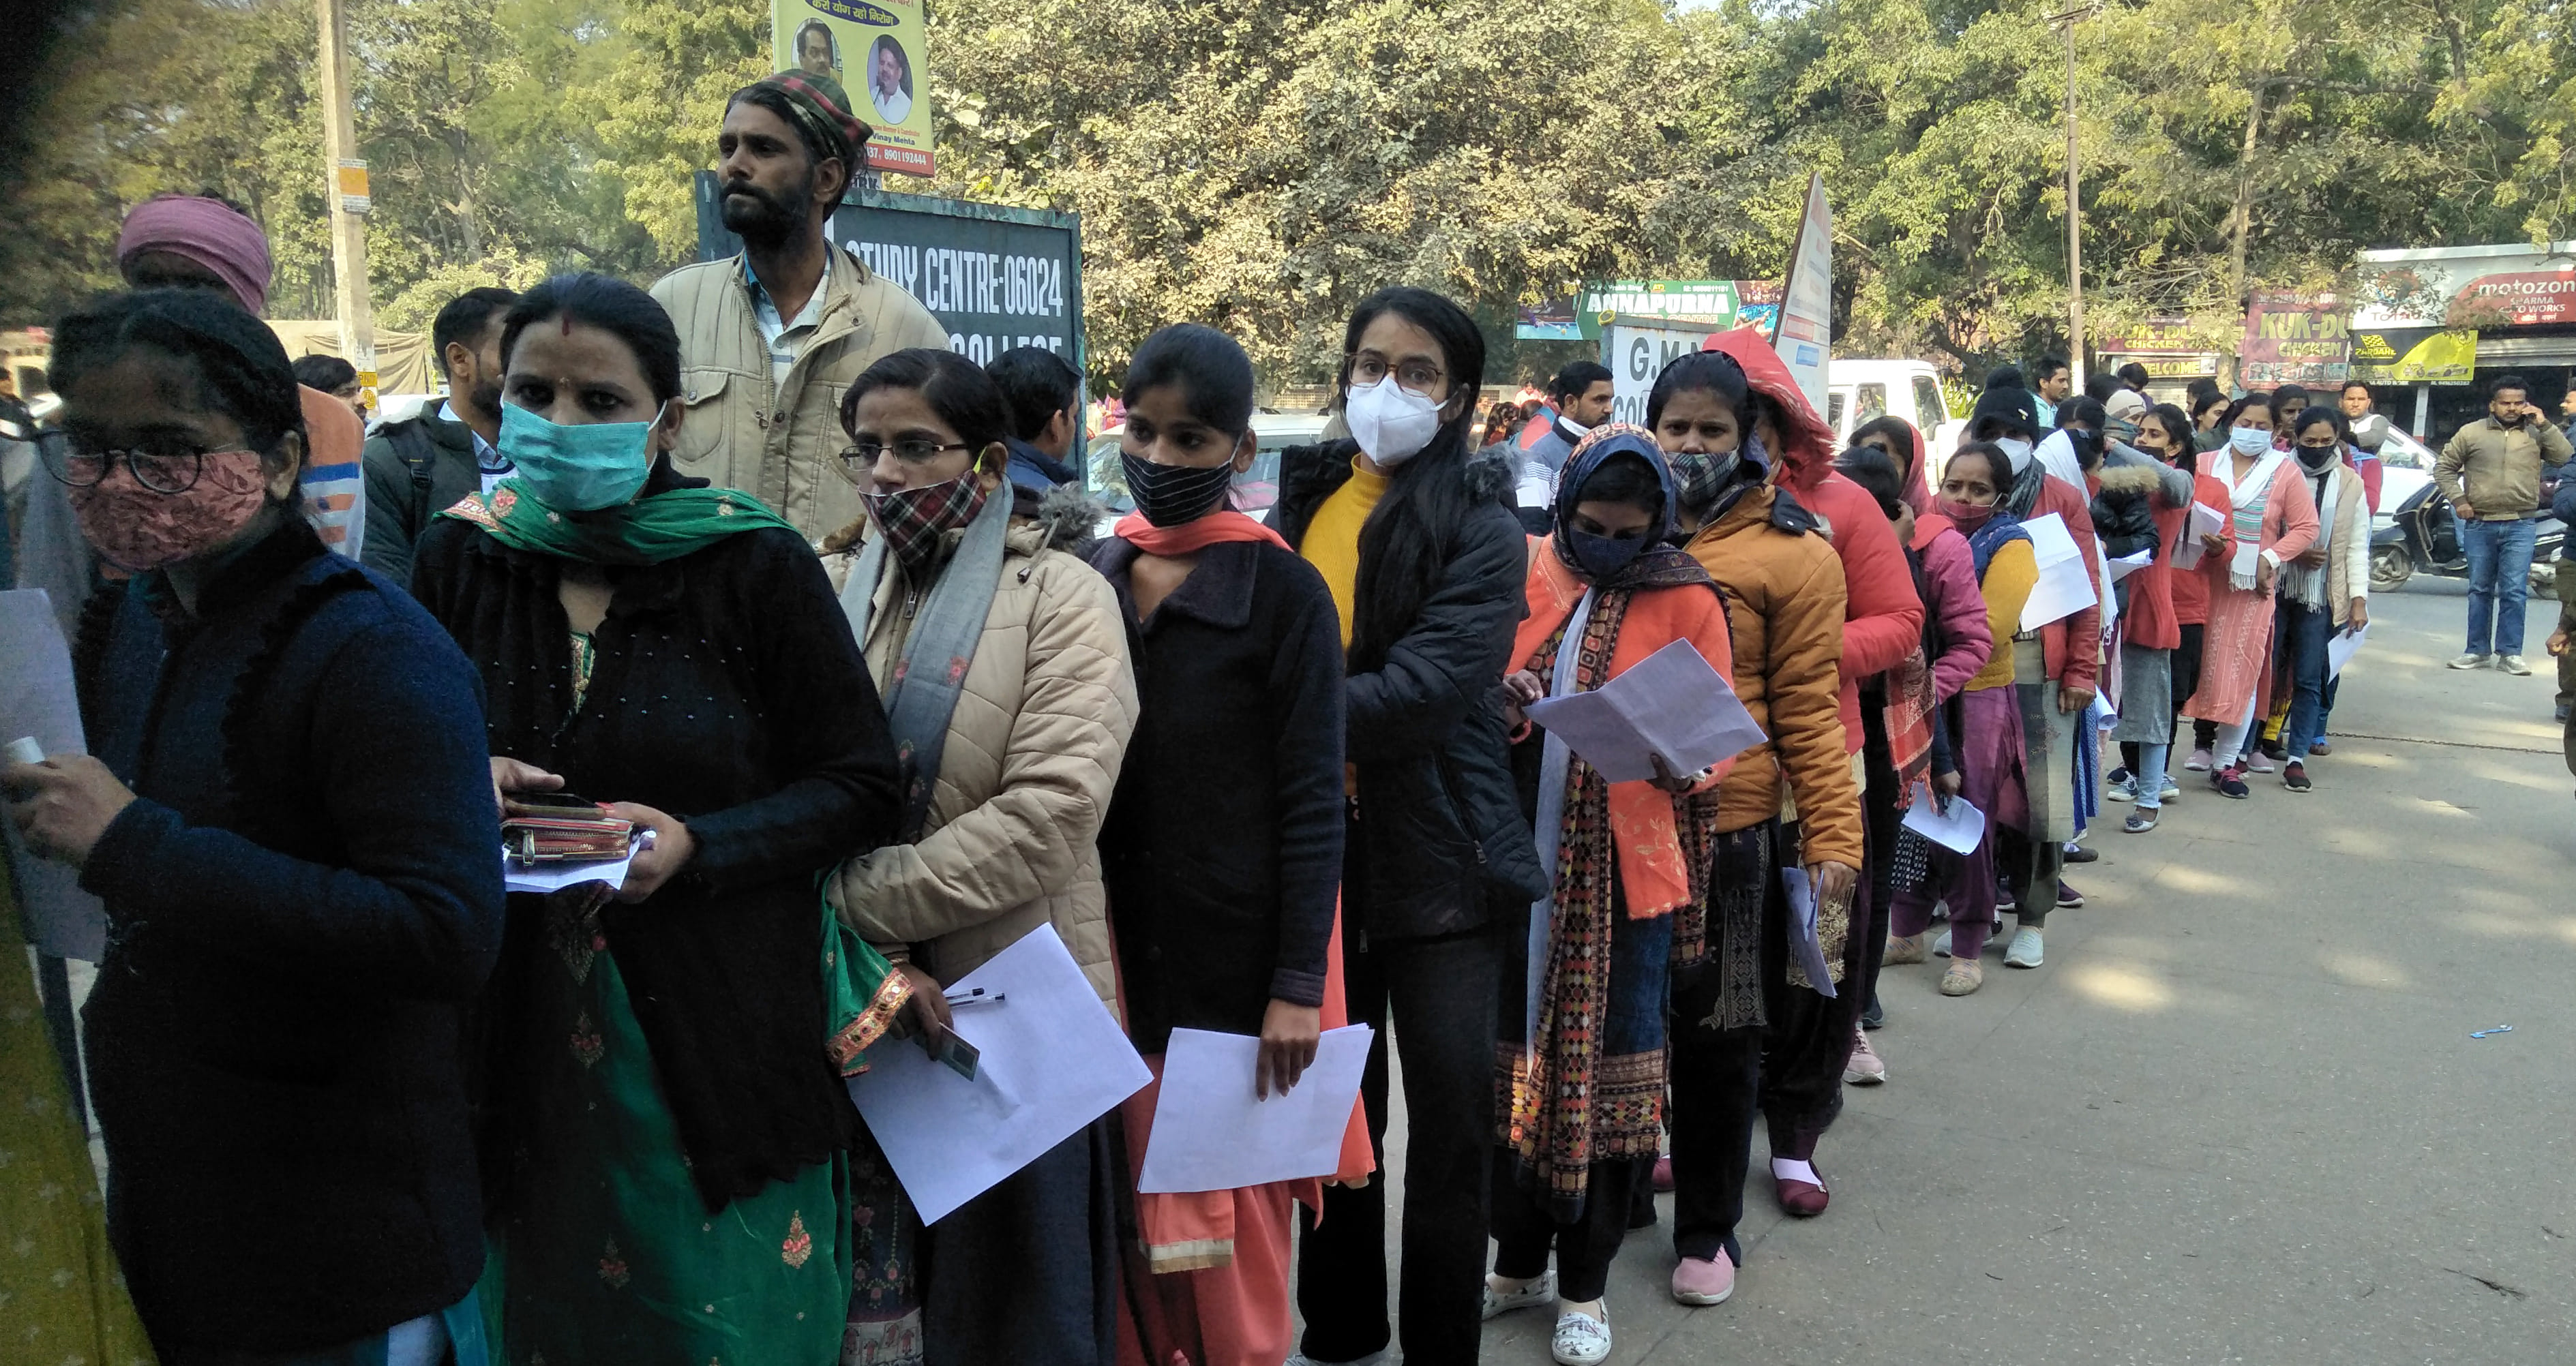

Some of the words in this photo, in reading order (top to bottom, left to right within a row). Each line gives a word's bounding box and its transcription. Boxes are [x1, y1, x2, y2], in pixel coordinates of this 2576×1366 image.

[832, 1, 851, 15] योग
[869, 8, 894, 25] निरोग
[873, 133, 892, 143] Vinay
[894, 136, 915, 145] Mehta
[1586, 294, 1730, 314] ANNAPURNA
[2528, 304, 2566, 313] WORKS
